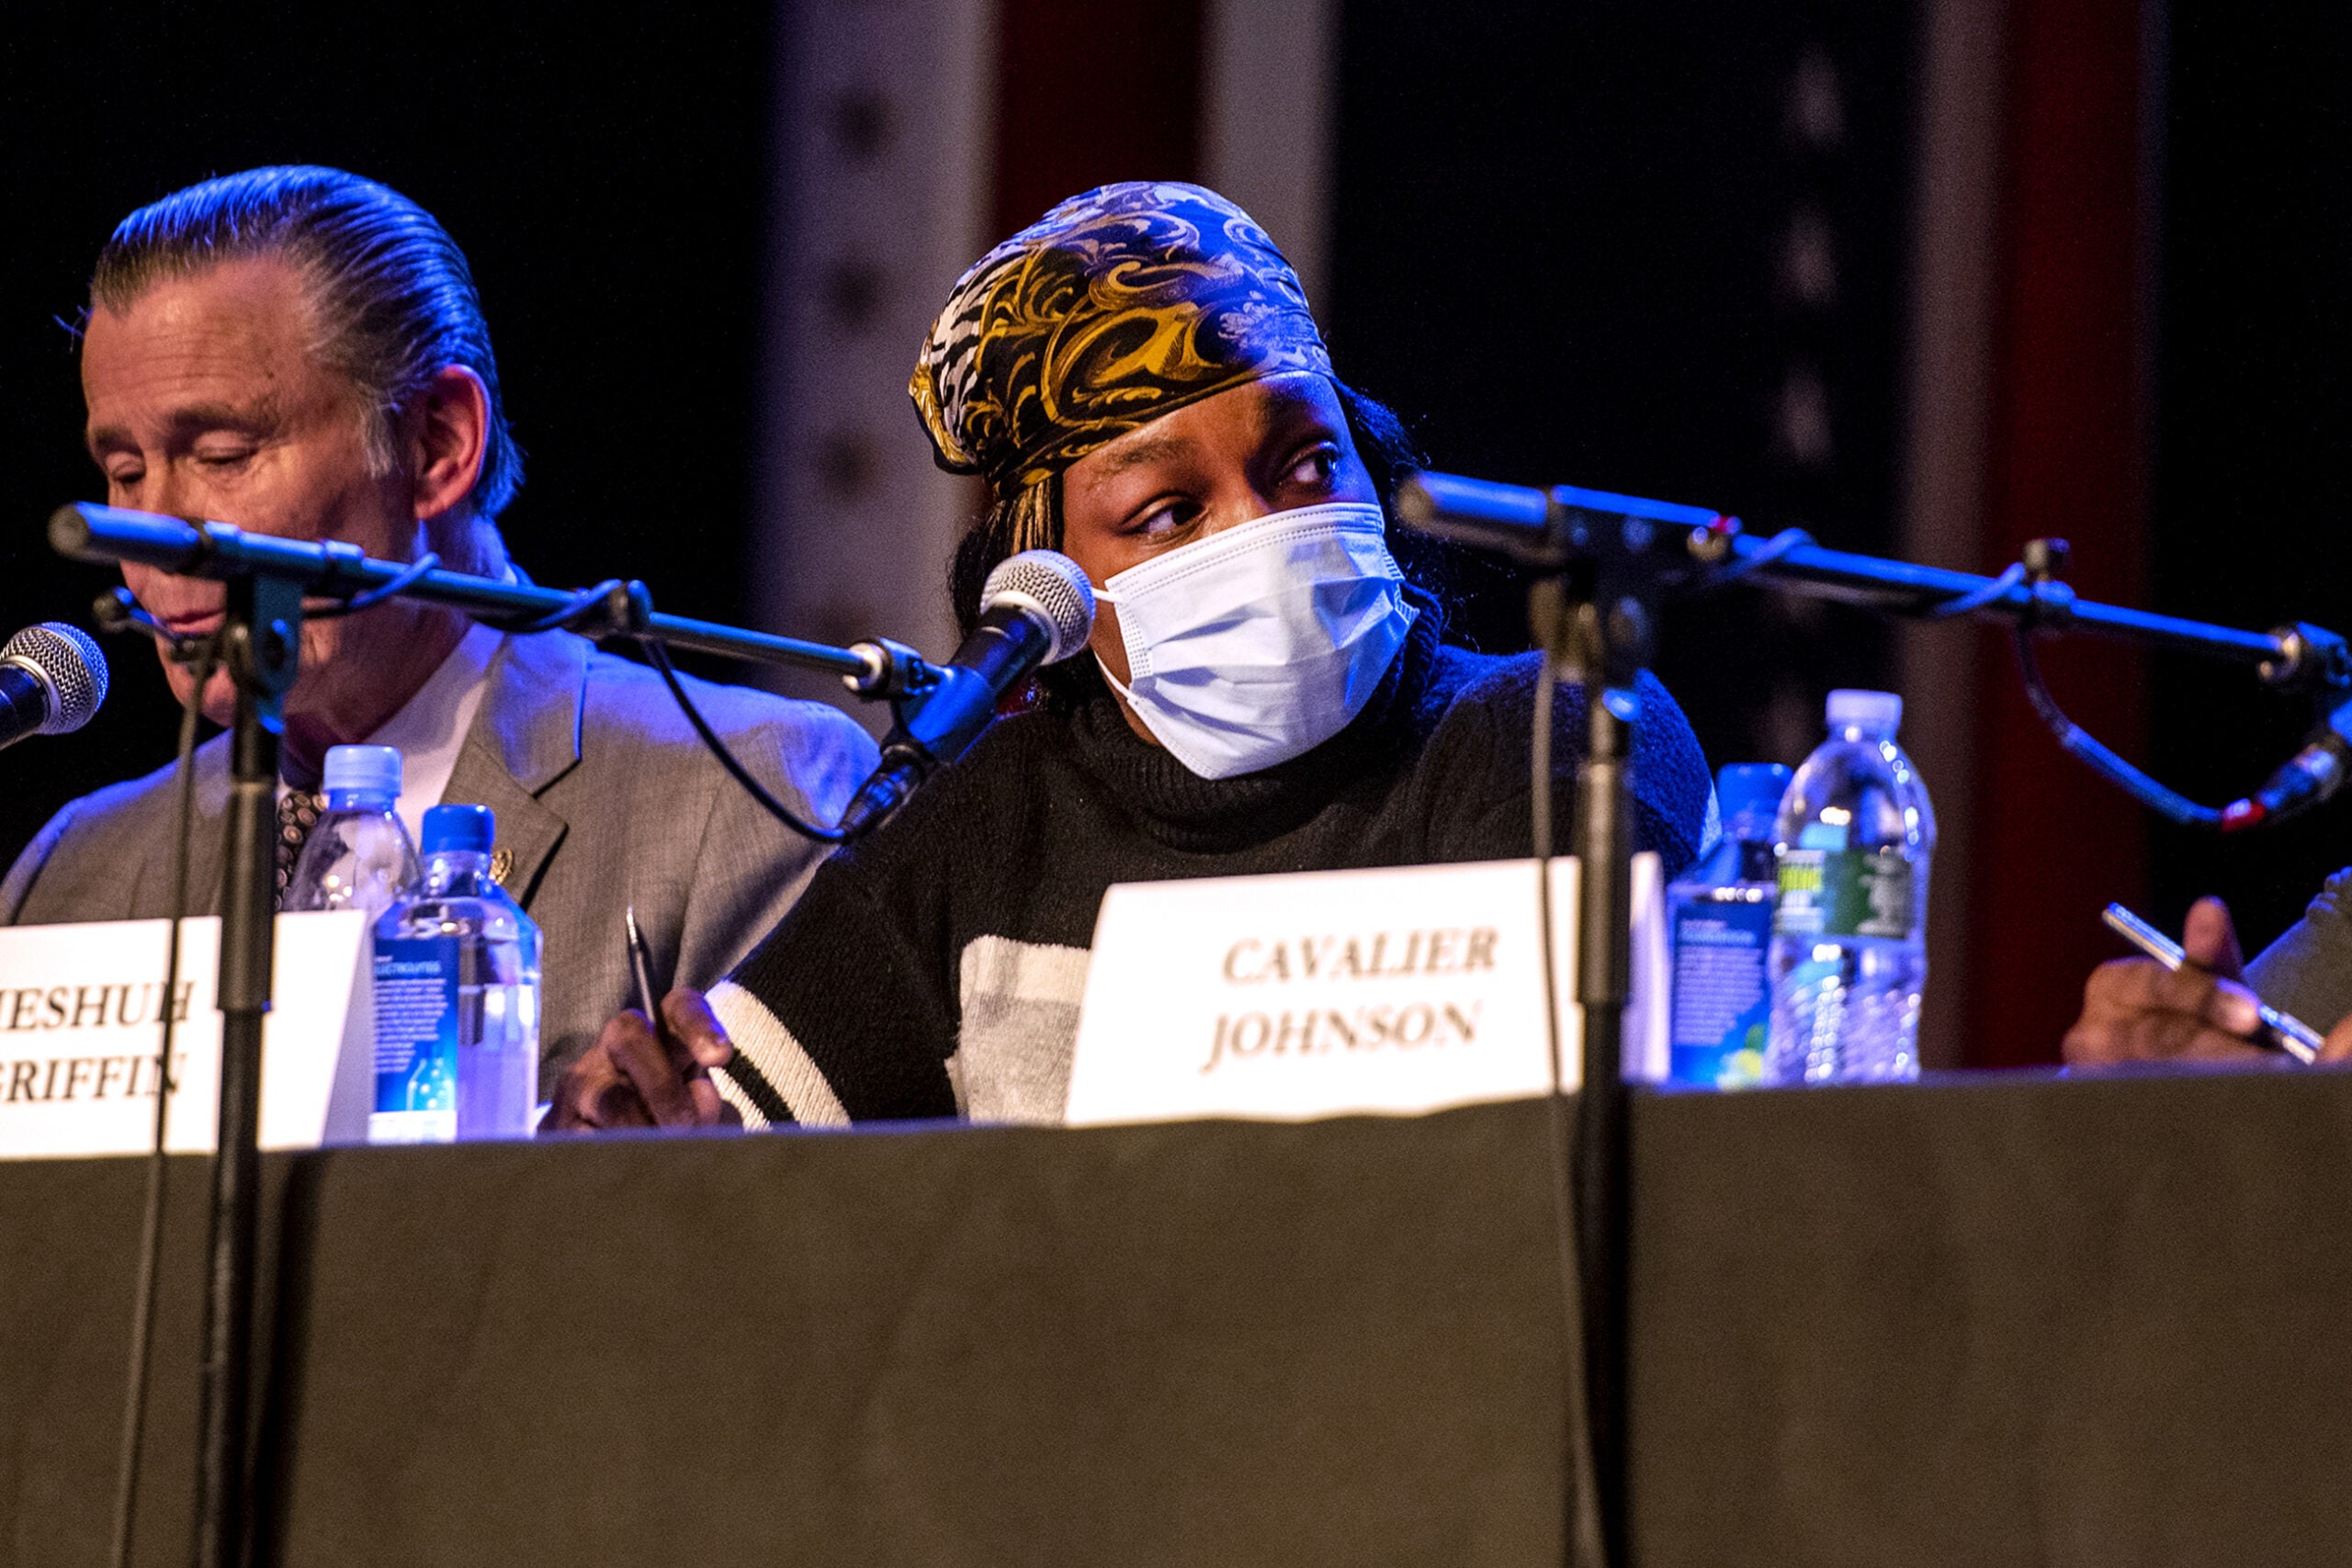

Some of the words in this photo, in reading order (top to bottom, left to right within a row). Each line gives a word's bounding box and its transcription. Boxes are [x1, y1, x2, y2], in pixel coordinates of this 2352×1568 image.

[1223, 927, 1497, 984] CAVALIER
[1199, 1000, 1482, 1074] JOHNSON
[0, 1054, 187, 1101] RIFFIN
